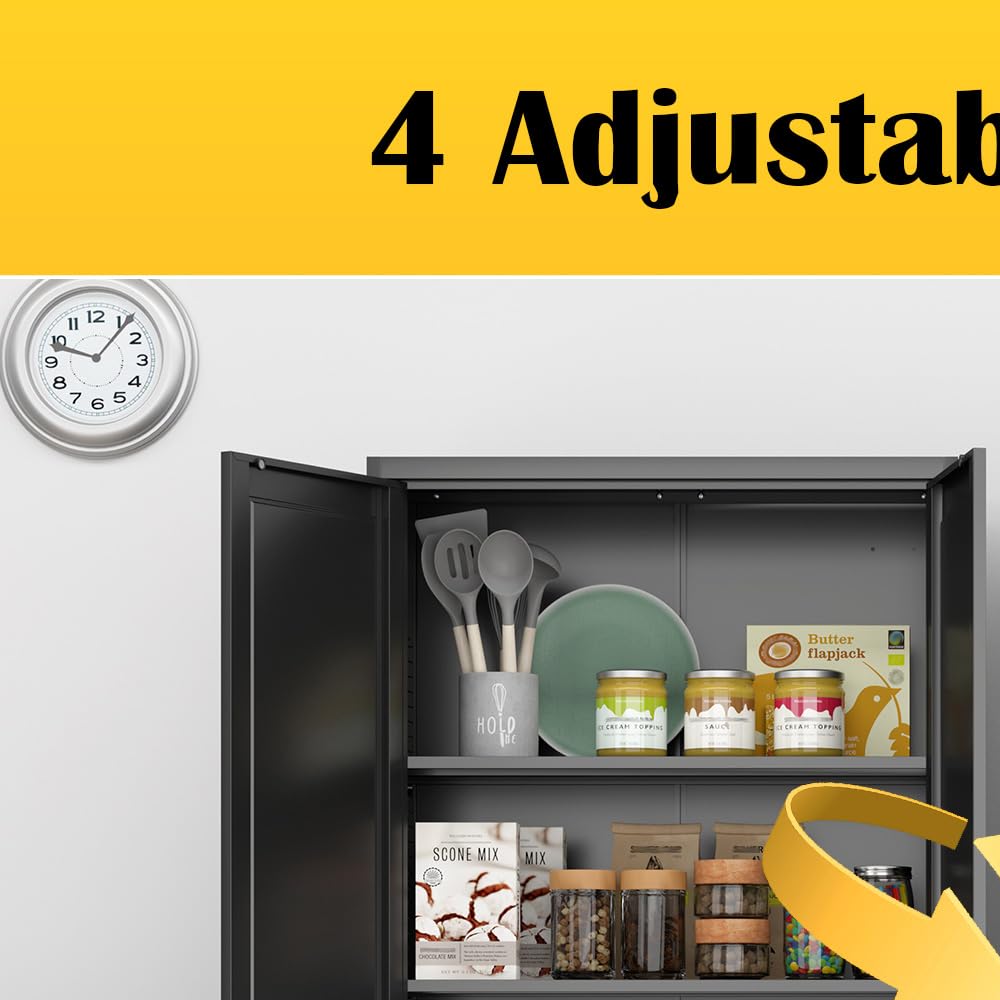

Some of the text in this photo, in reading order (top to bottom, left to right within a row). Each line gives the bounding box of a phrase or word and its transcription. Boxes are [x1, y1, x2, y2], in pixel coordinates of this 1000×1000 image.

[87, 310, 105, 323] 12
[68, 317, 78, 330] 11
[129, 332, 142, 344] 2
[44, 356, 58, 368] 9
[136, 354, 149, 366] 3
[52, 376, 67, 389] 8
[127, 375, 142, 387] 4
[69, 392, 82, 404] 7
[113, 391, 127, 403] 5
[91, 398, 104, 410] 6
[808, 633, 855, 644] Butter
[808, 647, 866, 661] flapjack
[433, 847, 499, 861] SCONE MIX
[525, 851, 546, 865] MIX
